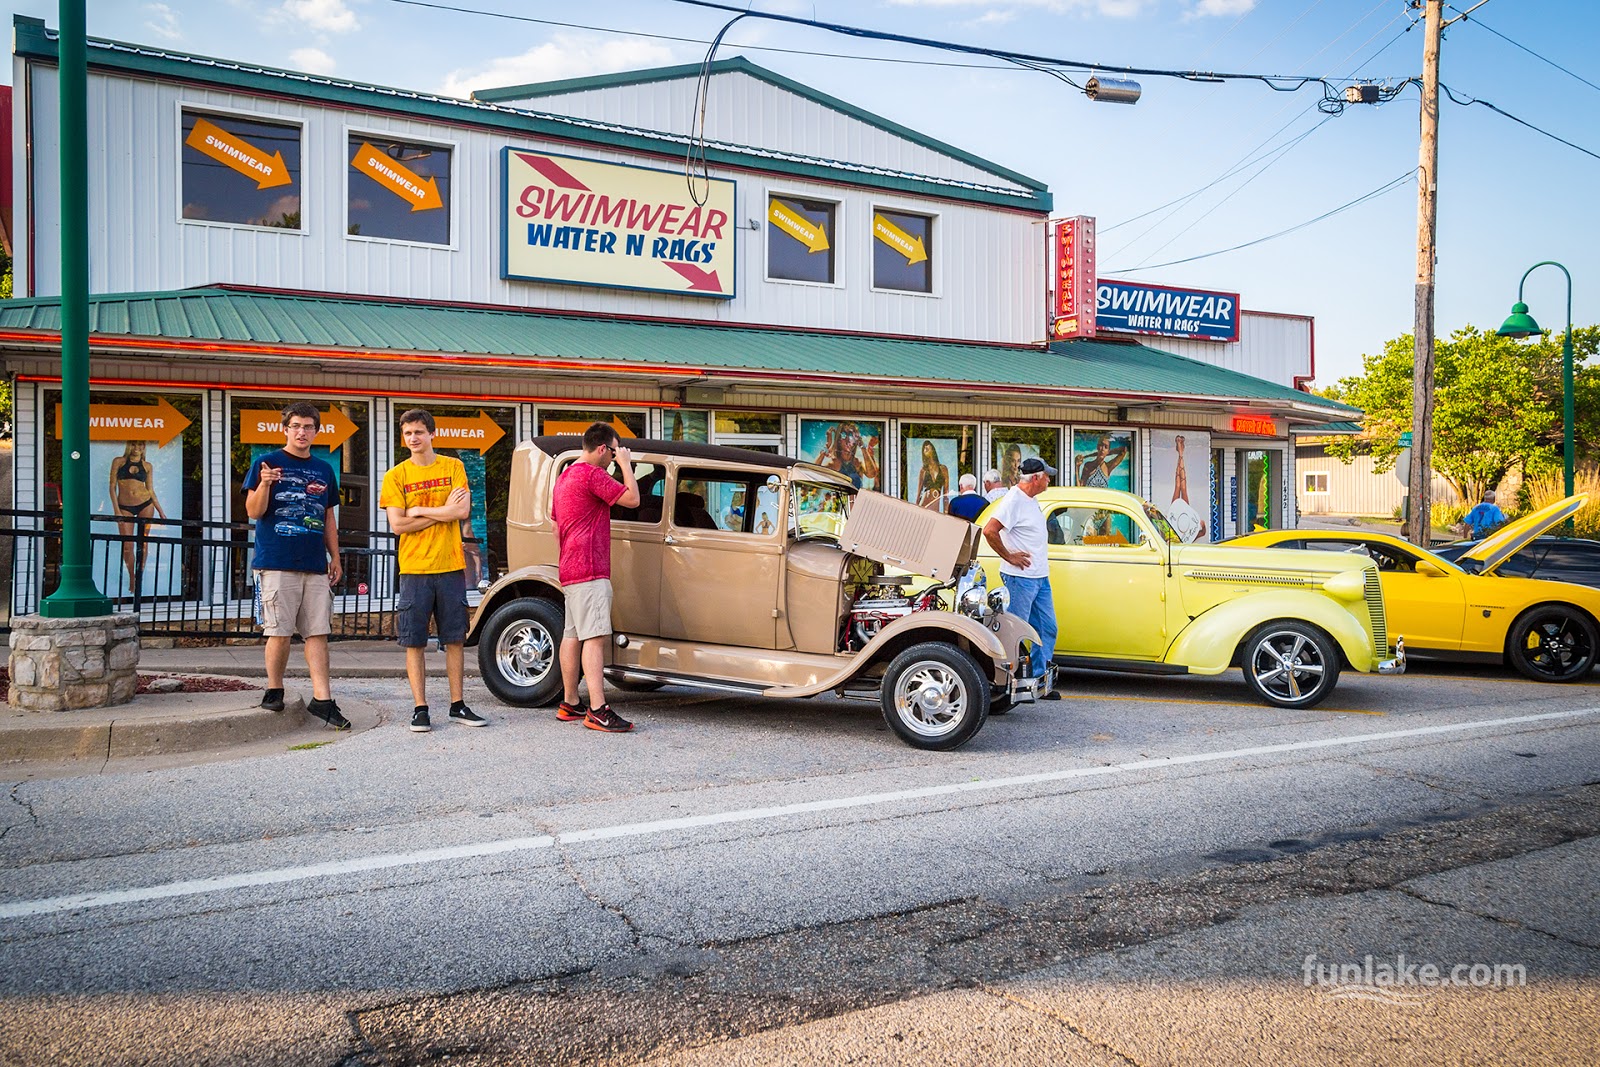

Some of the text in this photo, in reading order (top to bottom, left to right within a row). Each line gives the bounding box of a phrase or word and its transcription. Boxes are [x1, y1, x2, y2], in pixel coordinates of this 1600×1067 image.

[205, 135, 272, 176] SWIMWEAR
[368, 157, 425, 199] SWIMWEAR
[515, 185, 728, 240] SWIMWEAR
[773, 209, 815, 241] SWIMWEAR
[527, 223, 716, 264] WATER N RAGS
[876, 223, 914, 252] SWIMWEAR
[1097, 286, 1232, 320] SWIMWEAR
[1128, 314, 1200, 332] WATER N RAGS
[90, 417, 164, 428] WIMWEAR
[257, 422, 335, 434] SWIAR
[435, 428, 485, 438] IMWEAR
